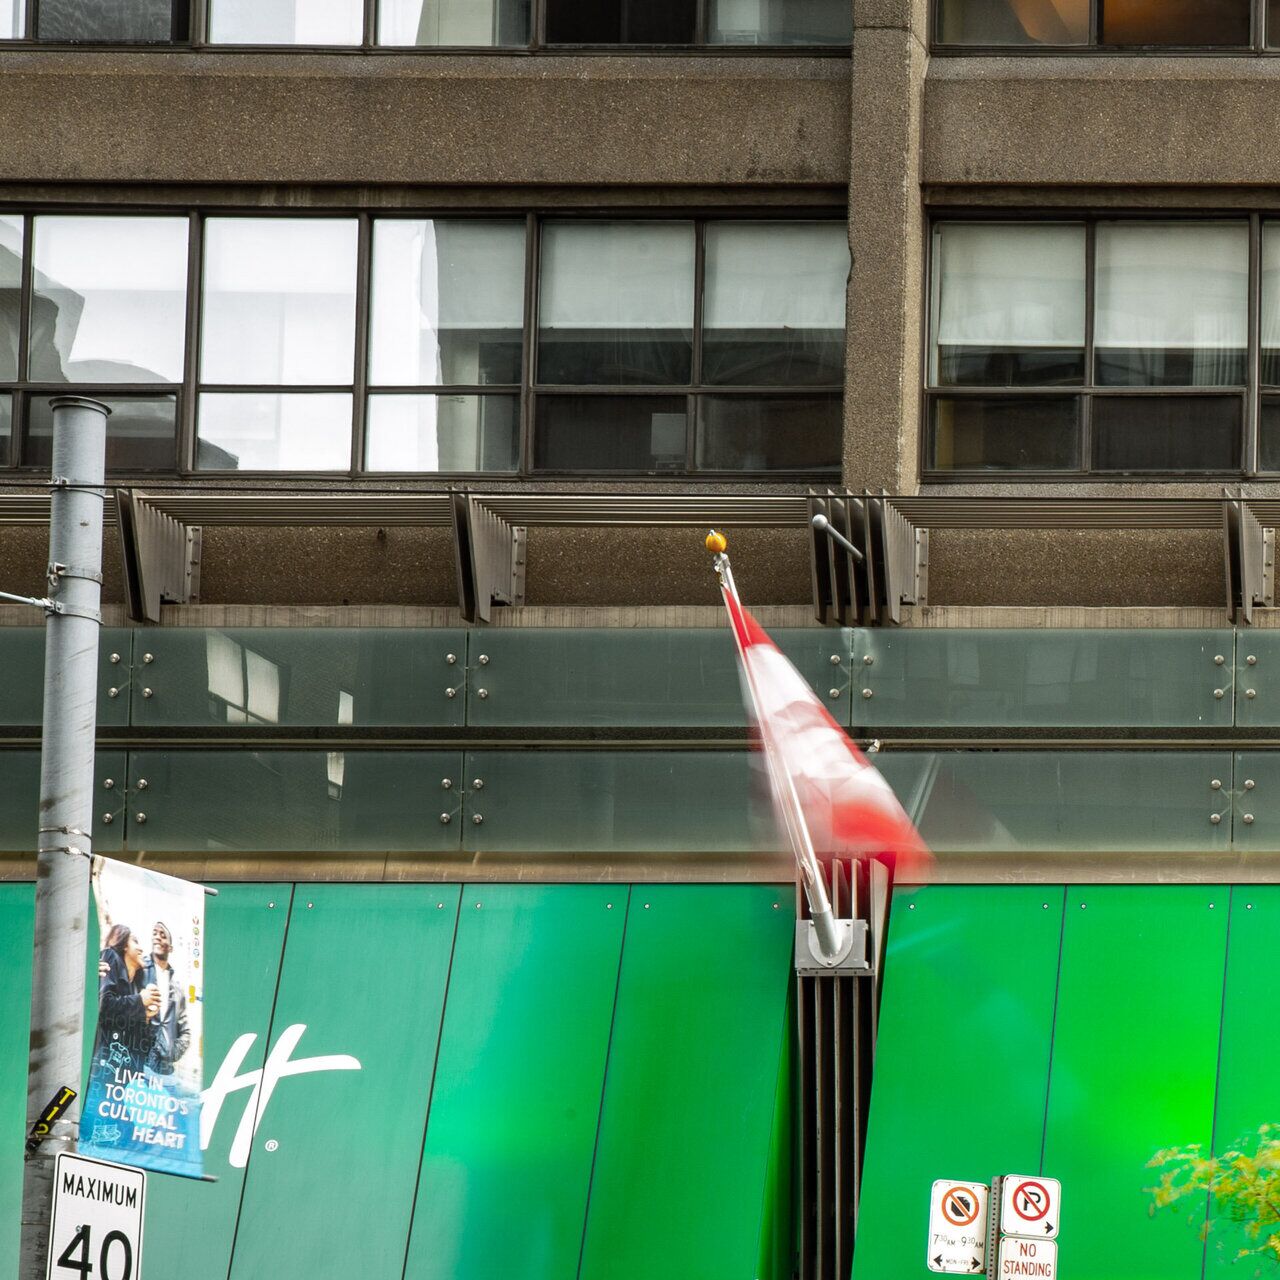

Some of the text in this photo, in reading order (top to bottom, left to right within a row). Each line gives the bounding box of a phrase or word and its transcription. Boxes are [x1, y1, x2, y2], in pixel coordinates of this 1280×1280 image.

[114, 1067, 165, 1092] LIVE IN
[105, 1083, 189, 1116] TORONTO'S
[98, 1101, 179, 1131] CULTURAL
[131, 1126, 187, 1150] HEART
[63, 1172, 137, 1209] MAXIMUM
[1019, 1243, 1037, 1258] NO
[1003, 1260, 1052, 1278] STANDING
